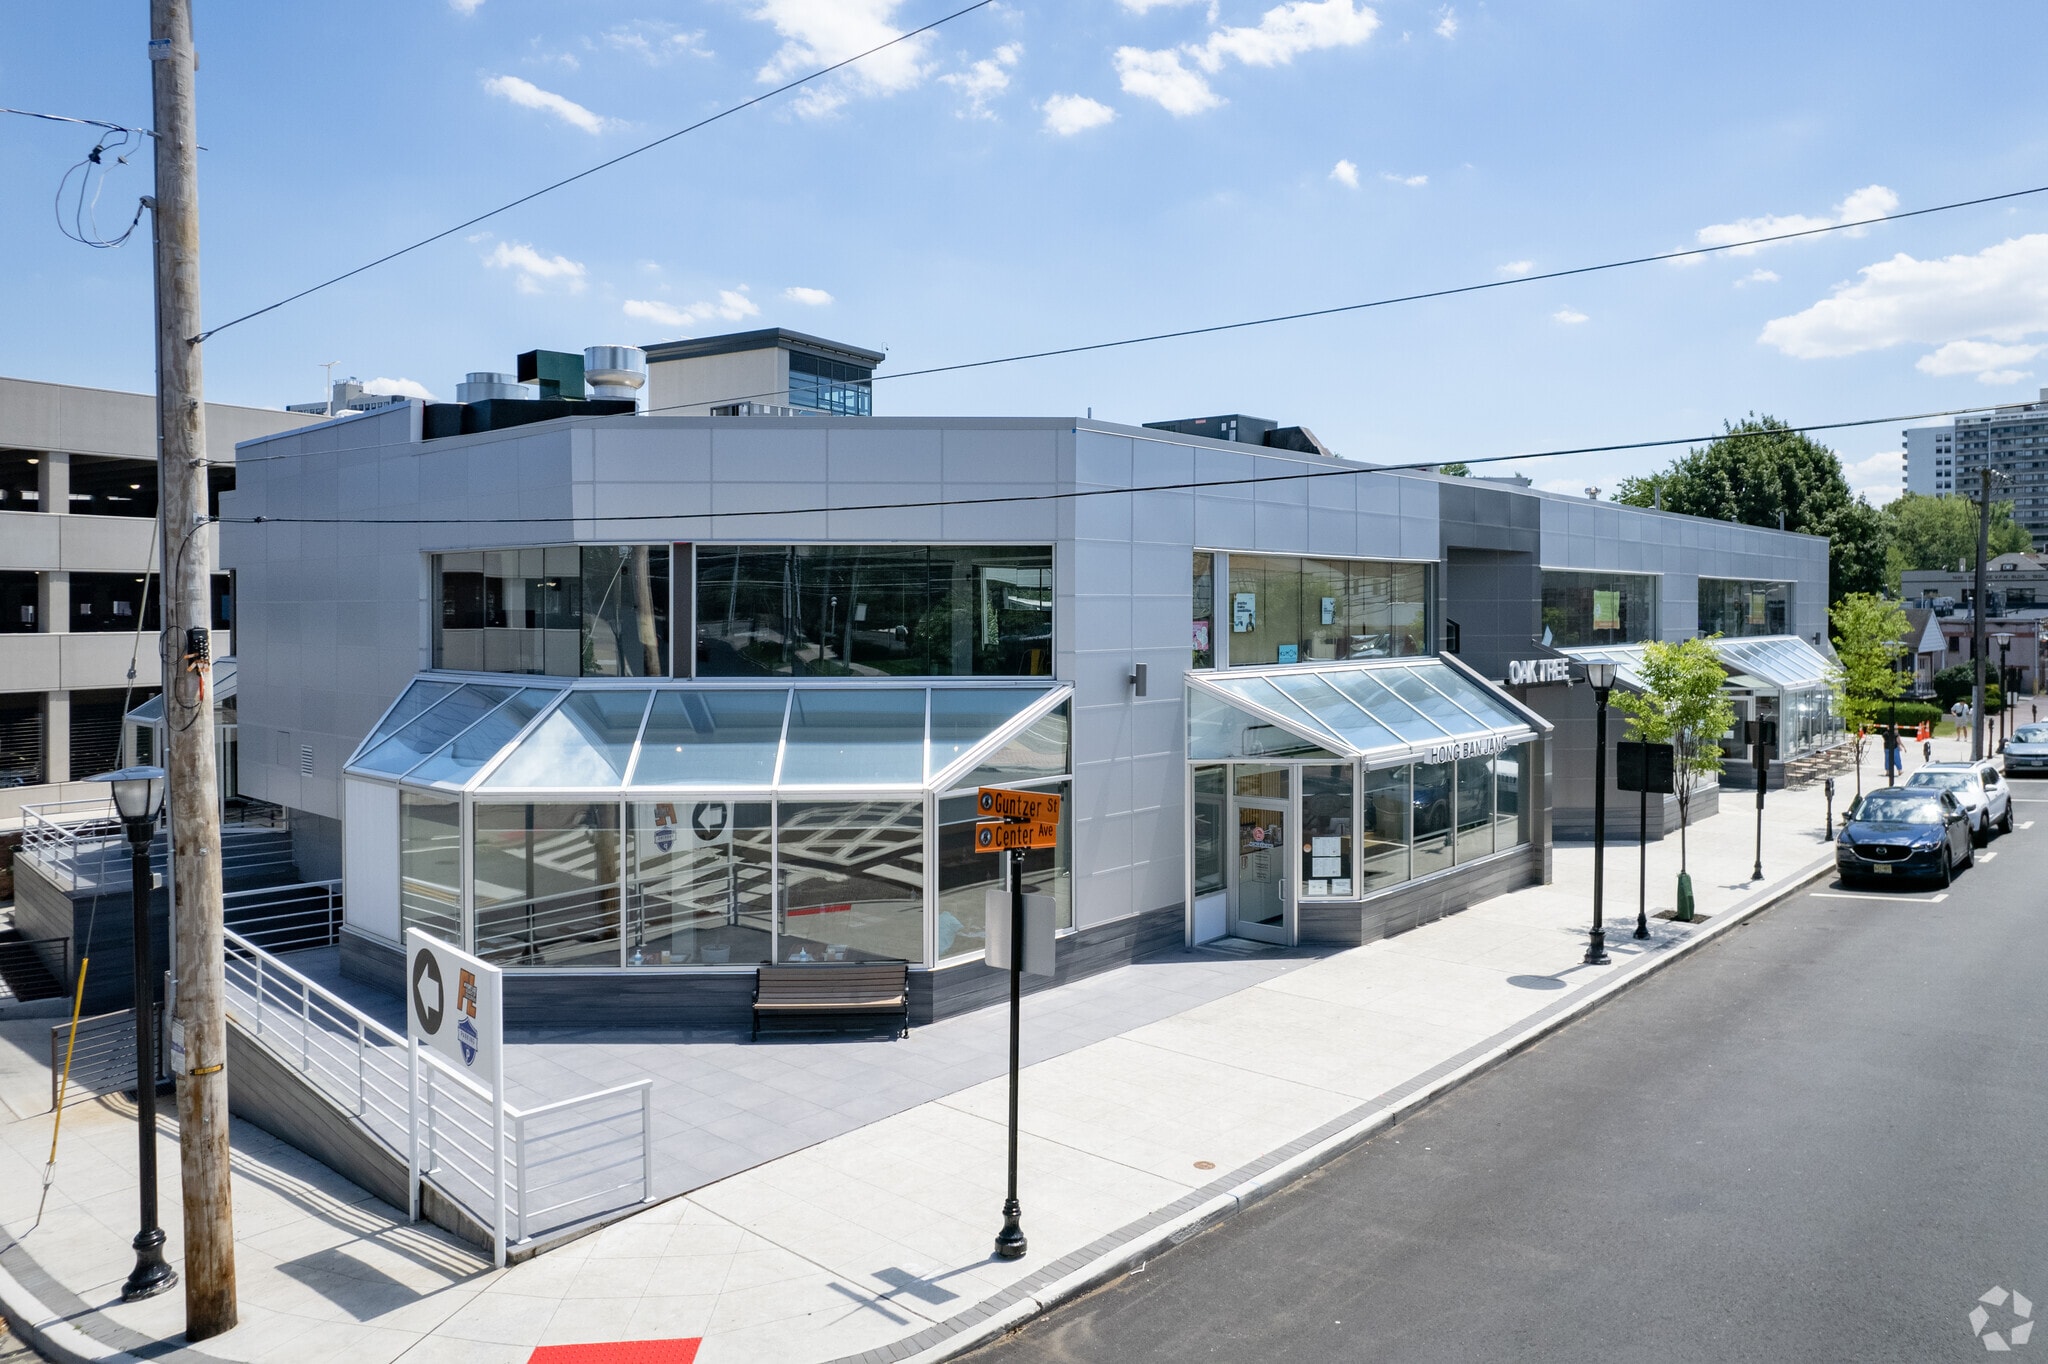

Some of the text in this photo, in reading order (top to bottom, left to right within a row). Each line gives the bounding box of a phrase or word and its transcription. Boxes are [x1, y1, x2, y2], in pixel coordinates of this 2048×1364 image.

[1509, 657, 1570, 685] OAK TREE
[1431, 735, 1508, 764] HONG BAN JANG
[995, 793, 1058, 817] Guntzer St
[995, 823, 1053, 847] Center Ave
